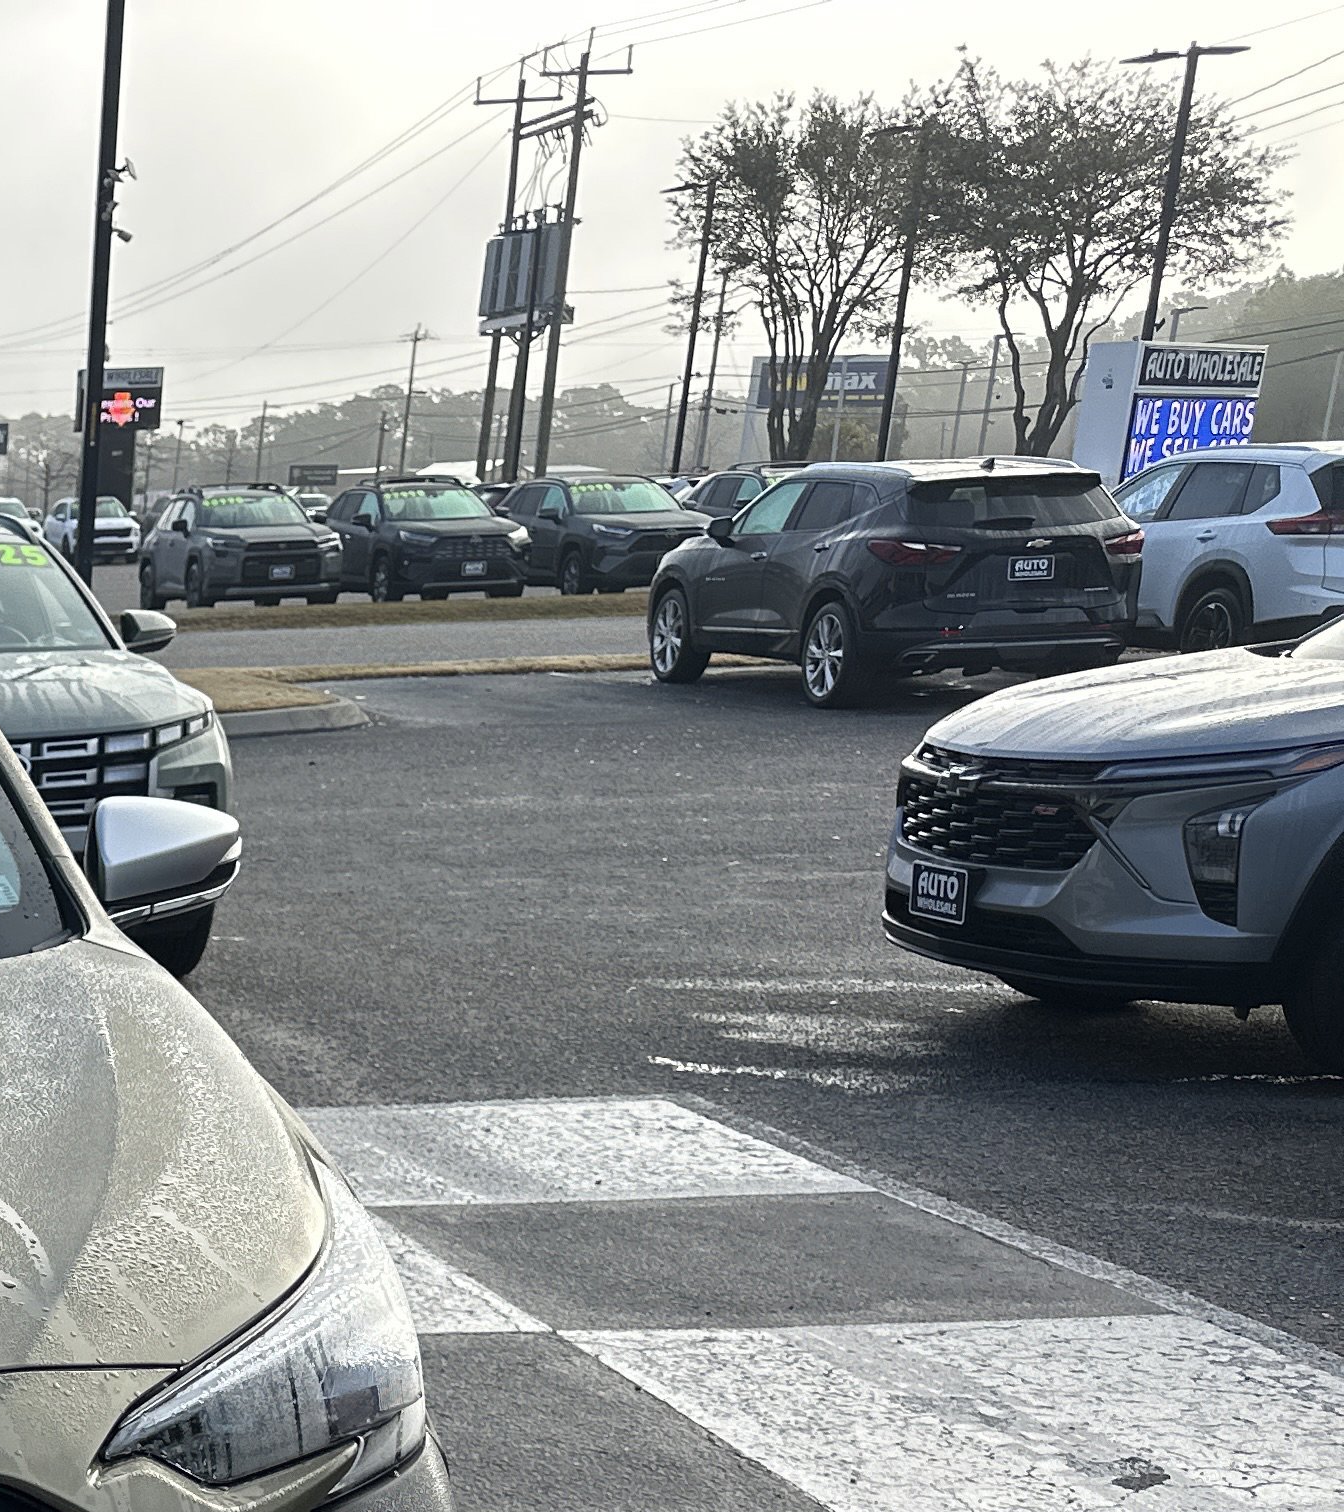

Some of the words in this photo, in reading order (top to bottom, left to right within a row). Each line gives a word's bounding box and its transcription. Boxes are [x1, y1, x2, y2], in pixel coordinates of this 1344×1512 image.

[1145, 351, 1185, 380] AUTO
[1187, 352, 1262, 382] WHOLESALE
[1134, 399, 1162, 435] WE
[1166, 400, 1206, 437] BUY
[1210, 401, 1255, 436] CARS
[1128, 438, 1155, 473] WE
[1015, 559, 1048, 571] AUTO
[918, 871, 959, 900] AUTO
[917, 895, 957, 916] WHOLESALE
